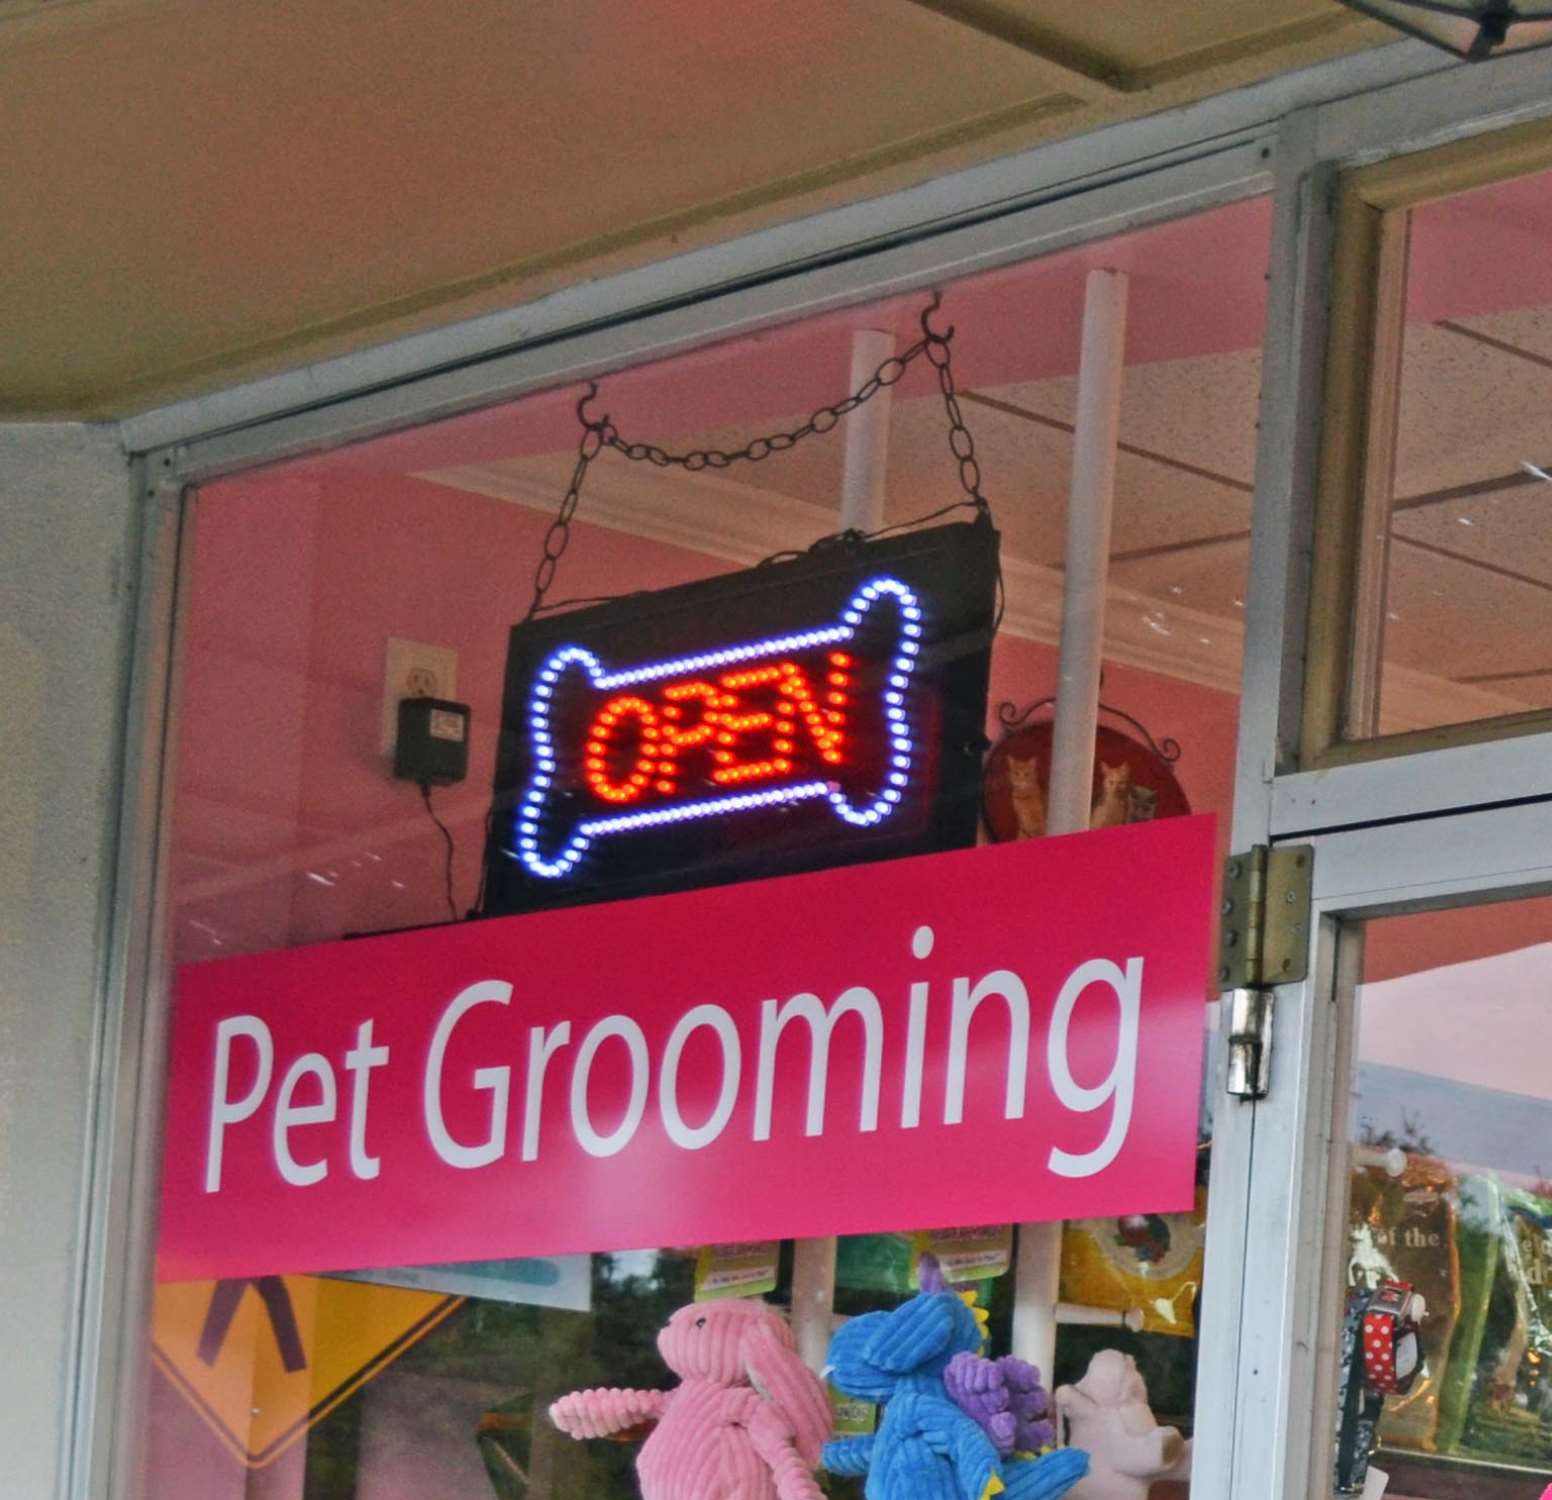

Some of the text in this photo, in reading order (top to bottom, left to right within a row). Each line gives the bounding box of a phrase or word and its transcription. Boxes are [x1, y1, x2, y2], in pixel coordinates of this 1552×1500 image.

[587, 650, 852, 802] OPEN
[204, 924, 1146, 1195] Pet Grooming
